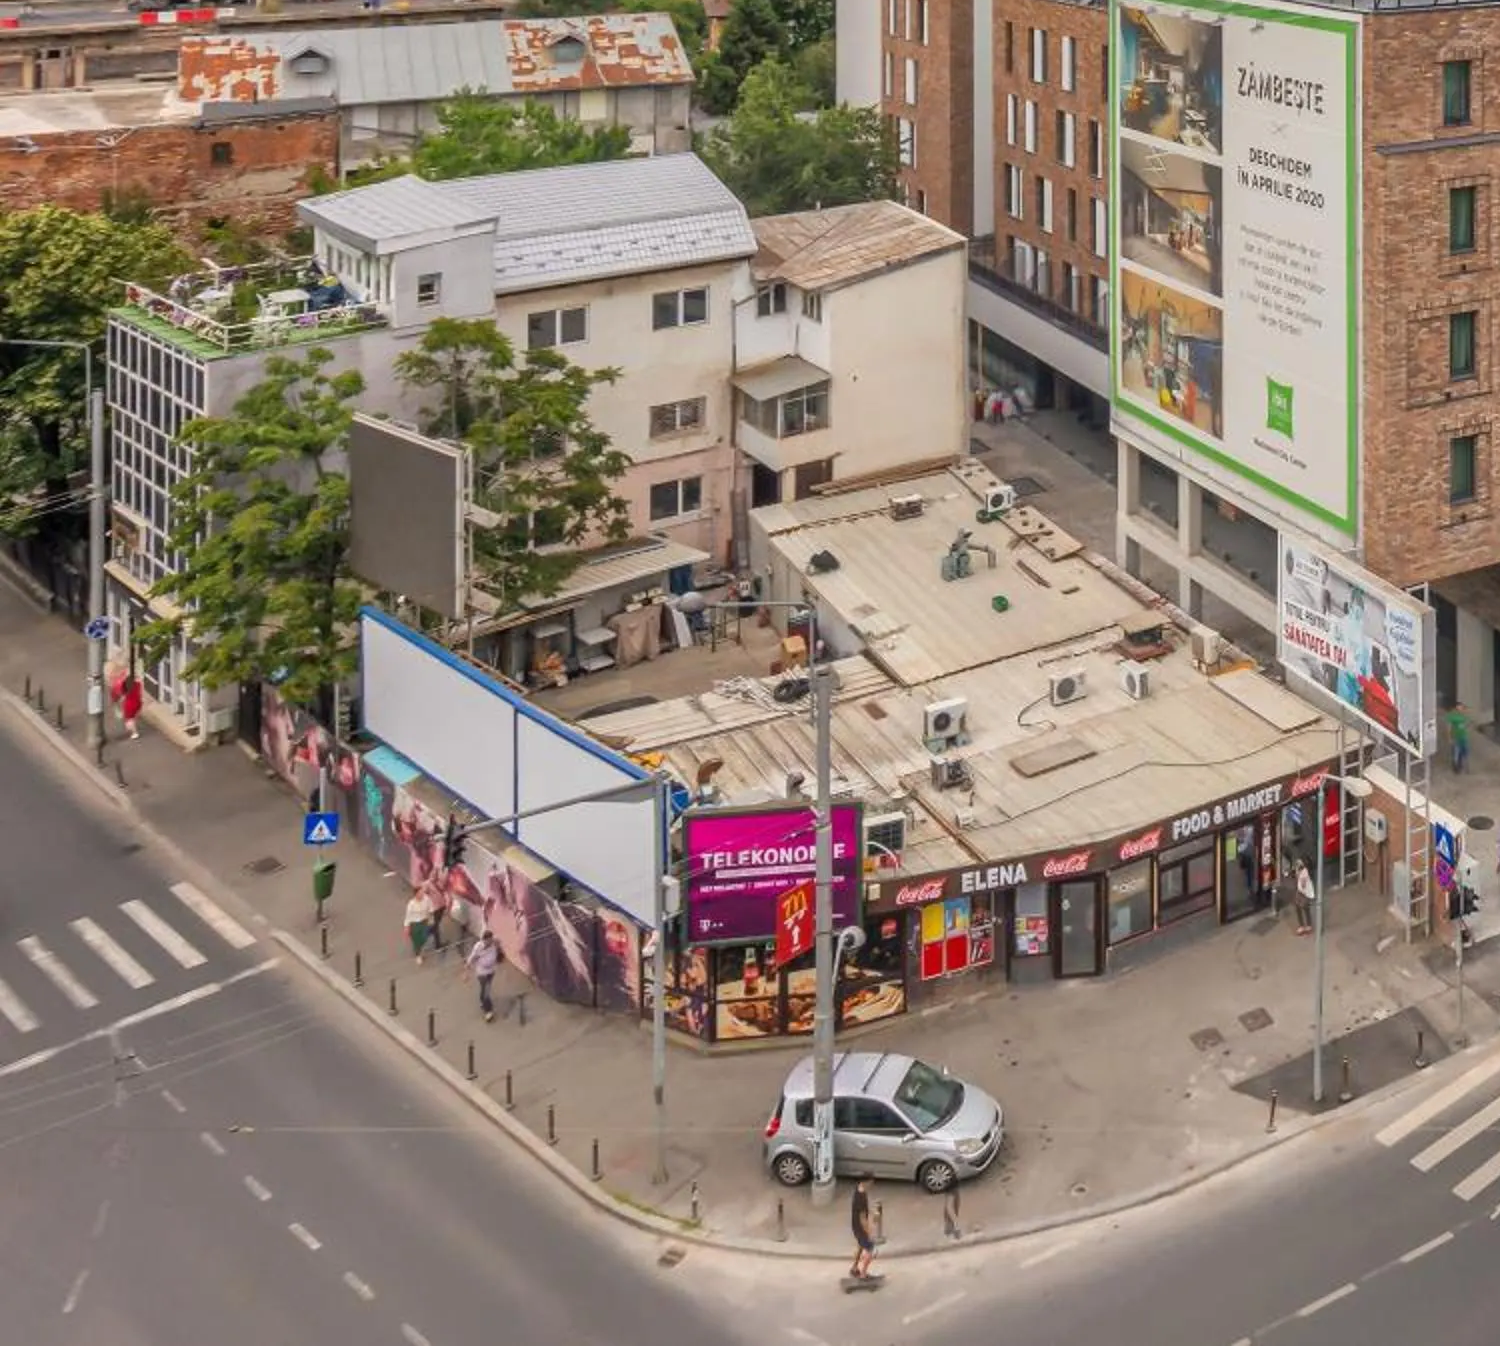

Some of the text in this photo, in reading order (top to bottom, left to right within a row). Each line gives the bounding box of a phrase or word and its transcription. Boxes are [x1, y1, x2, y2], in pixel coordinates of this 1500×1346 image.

[1249, 146, 1312, 178] DESCHIDEM
[1251, 173, 1293, 200] APRILIE
[1295, 186, 1326, 209] 2020
[1172, 783, 1283, 841] FOOD & MARKET
[701, 843, 846, 871] TELEKONOE
[960, 861, 1028, 894] ELENA
